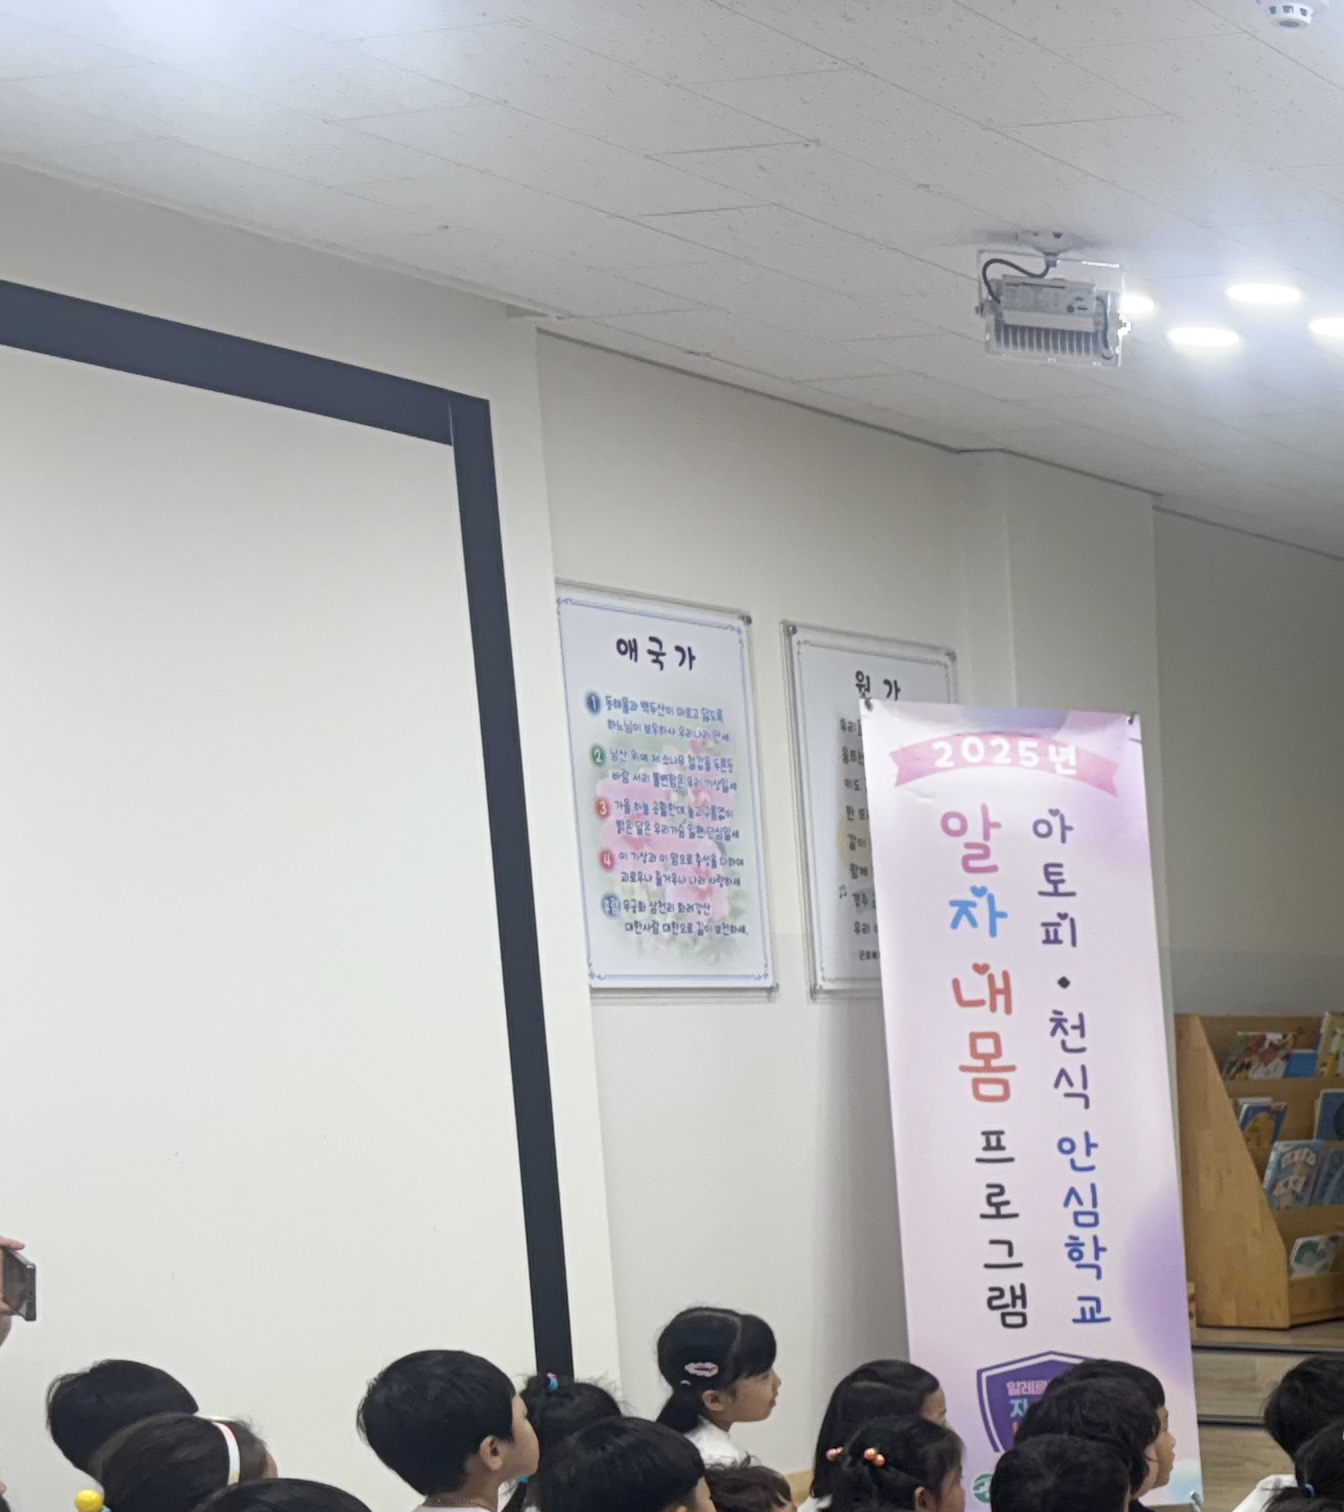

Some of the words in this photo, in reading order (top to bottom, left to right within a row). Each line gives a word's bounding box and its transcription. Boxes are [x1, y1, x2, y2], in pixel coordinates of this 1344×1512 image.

[615, 635, 697, 671] 애국가
[931, 736, 1077, 776] 2025년
[975, 1129, 1028, 1329] 프로그램
[1056, 1130, 1111, 1325] 안심학교
